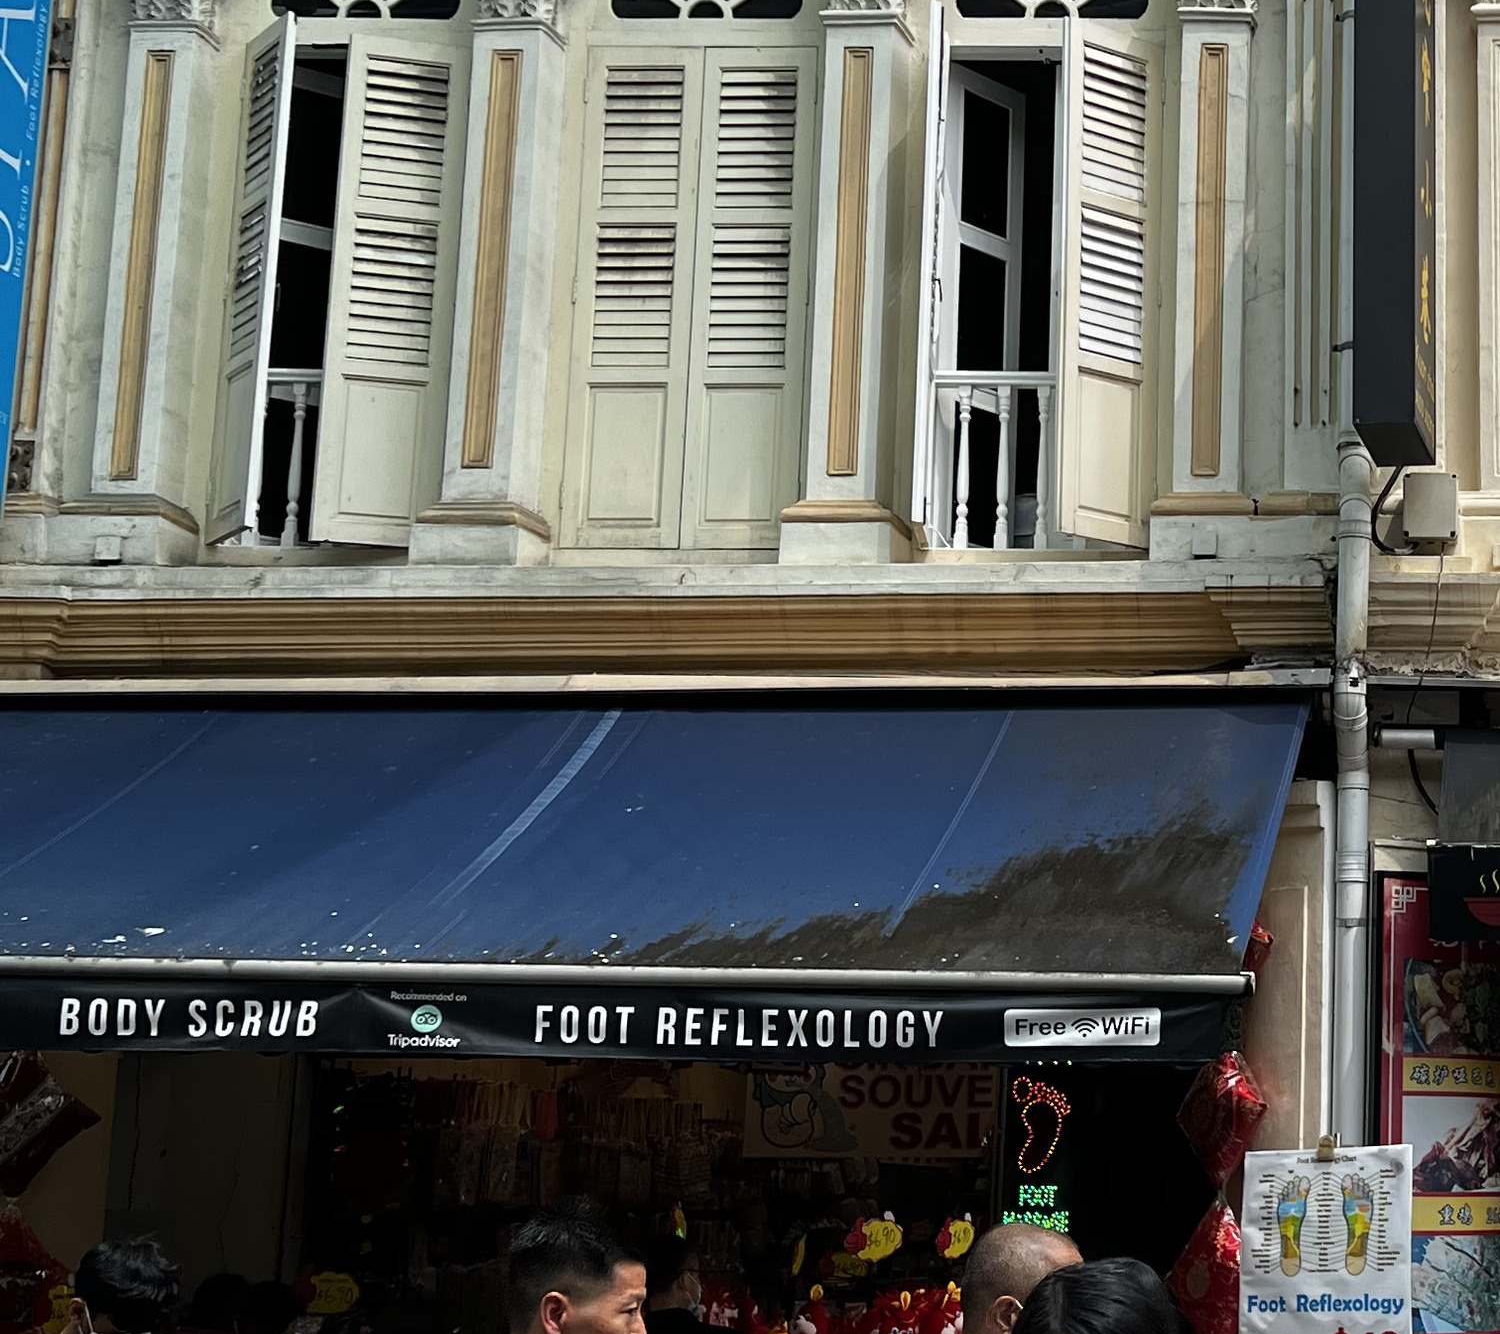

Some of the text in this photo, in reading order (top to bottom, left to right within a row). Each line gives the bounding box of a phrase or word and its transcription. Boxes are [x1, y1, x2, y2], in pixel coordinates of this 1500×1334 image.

[12, 2, 49, 279] Body Scrub Foot Reflexology
[390, 990, 468, 1003] Recommended on
[58, 997, 319, 1038] BODY SCRUB
[533, 1004, 945, 1048] FOOT REFLEXOLOGY
[1015, 1016, 1152, 1037] Free WiFi
[387, 1033, 461, 1049] Tripadvisor
[1247, 1293, 1404, 1316] Foot Reflexology
